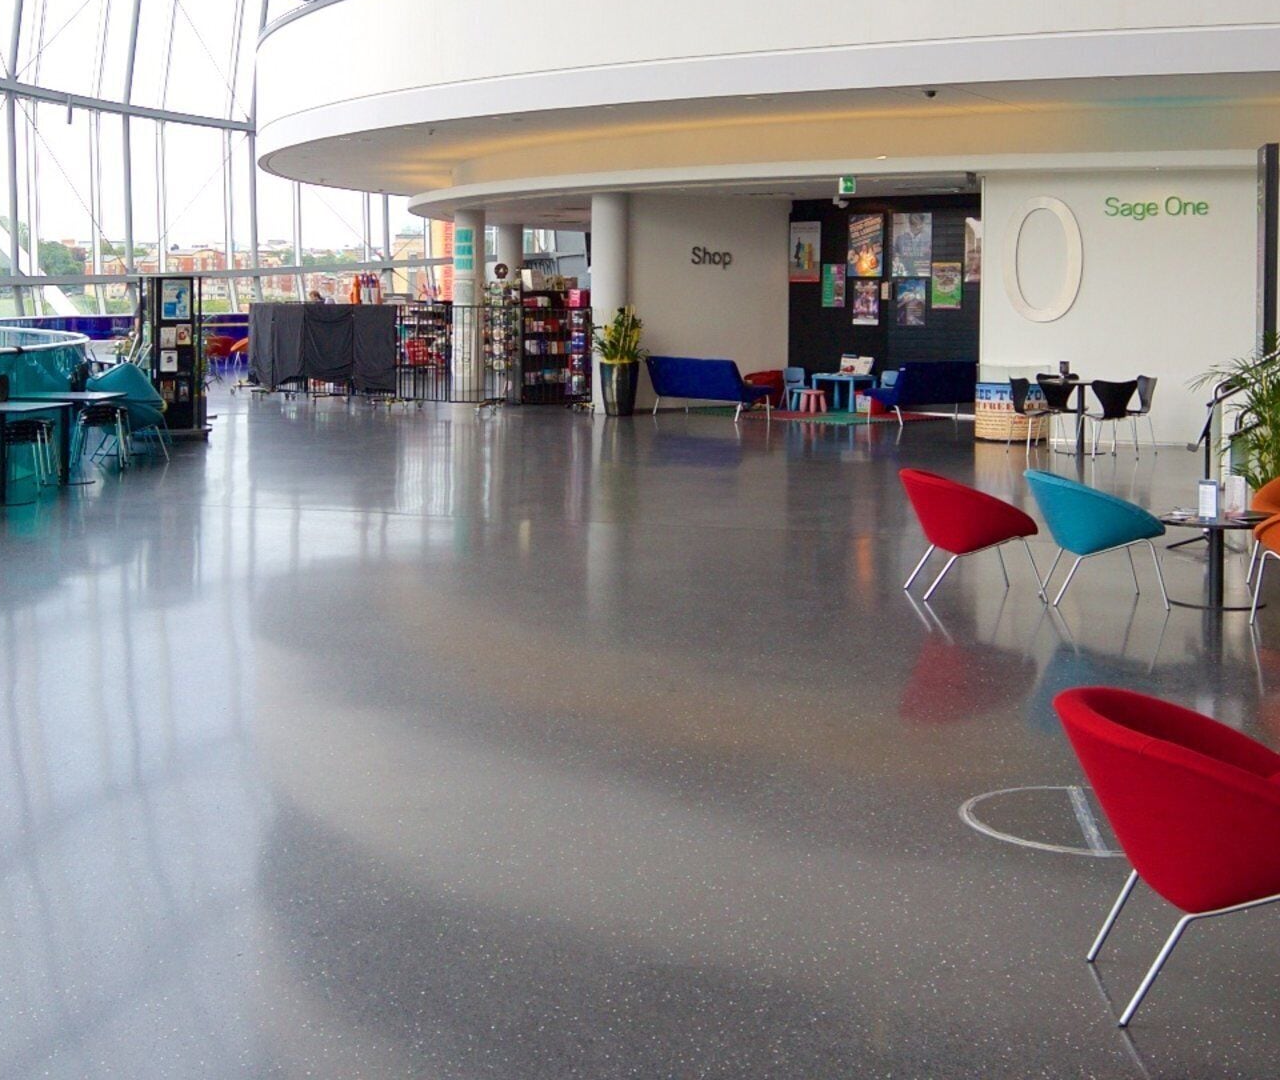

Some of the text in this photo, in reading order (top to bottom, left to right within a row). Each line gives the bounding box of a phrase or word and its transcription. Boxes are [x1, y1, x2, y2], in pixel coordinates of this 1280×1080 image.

[1104, 195, 1209, 221] Sage One
[691, 246, 732, 270] Shop
